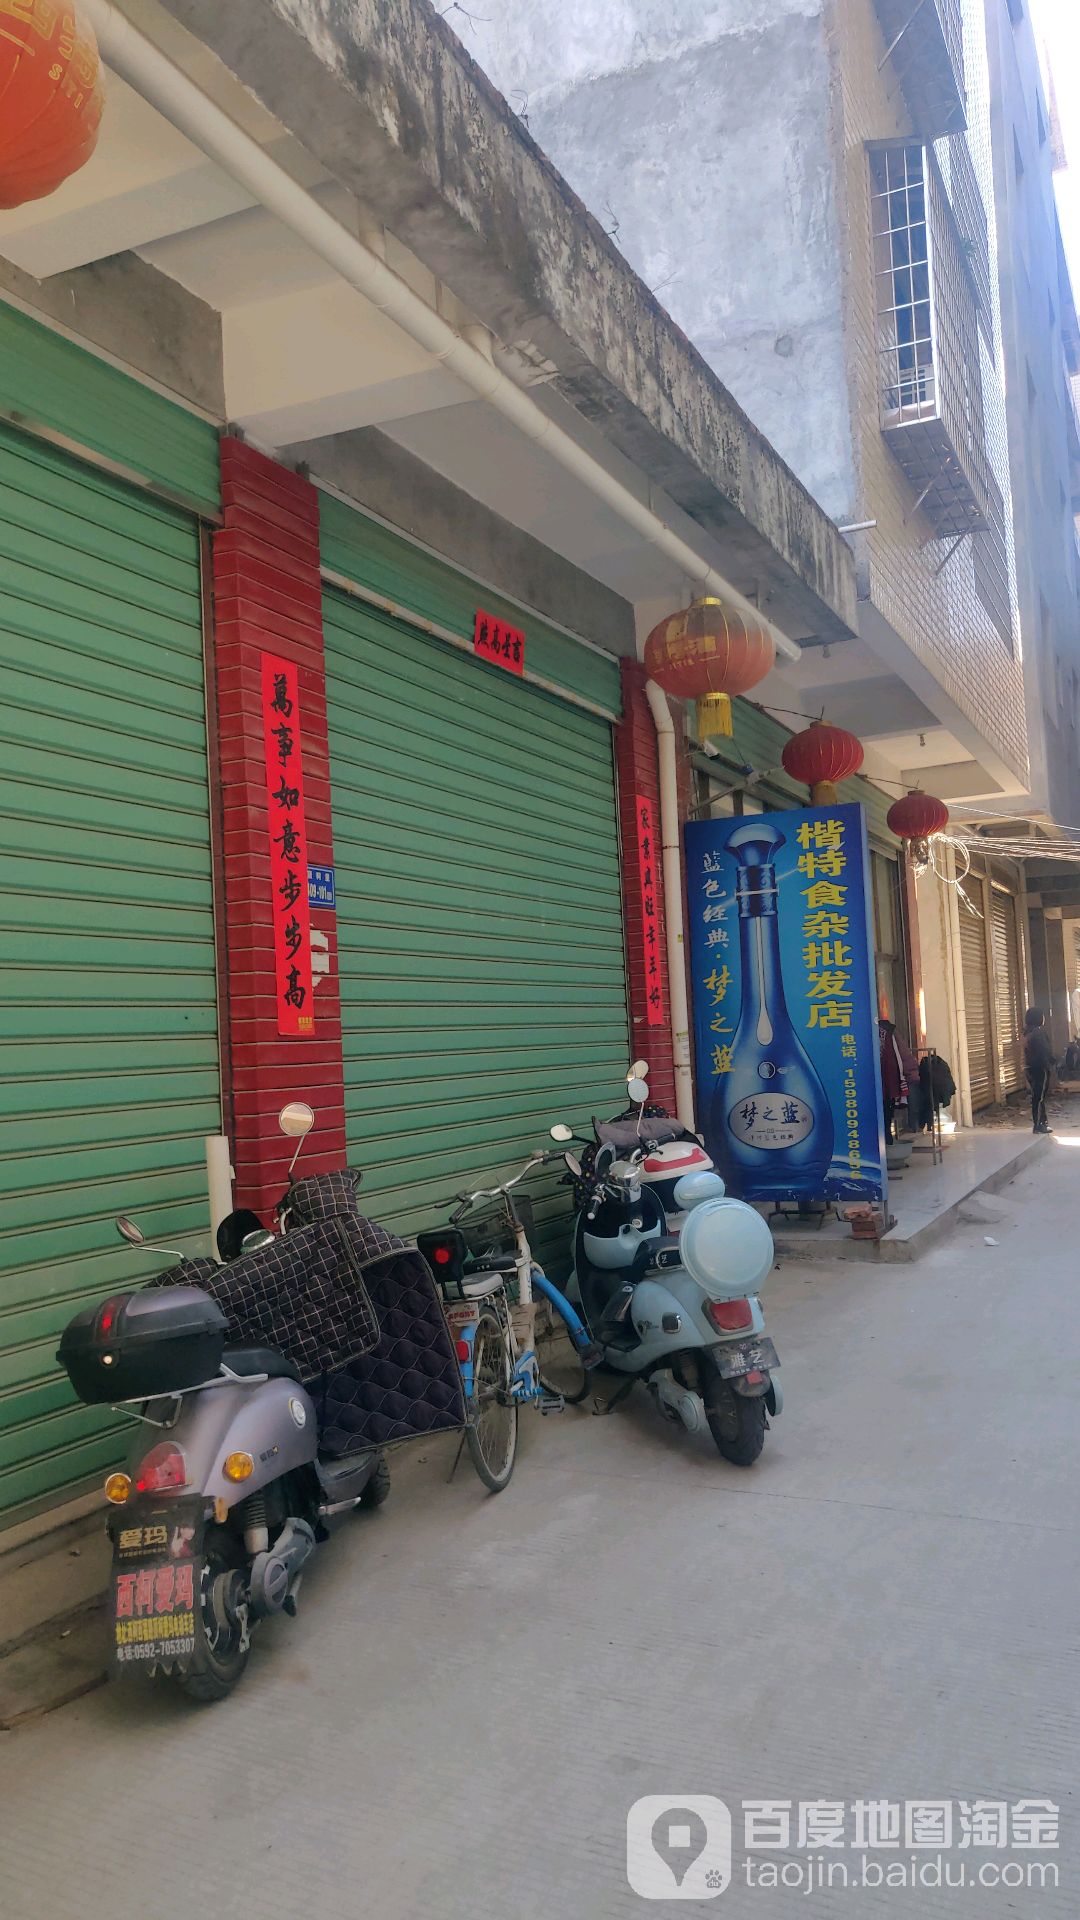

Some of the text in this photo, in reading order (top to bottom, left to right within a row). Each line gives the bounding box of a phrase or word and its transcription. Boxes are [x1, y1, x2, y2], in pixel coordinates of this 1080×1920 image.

[796, 819, 853, 1029] 楷特食杂批发店
[740, 1101, 800, 1130] 梦之蓝
[119, 1525, 168, 1548] 爱玛
[116, 1564, 194, 1617] 西柯爱玛
